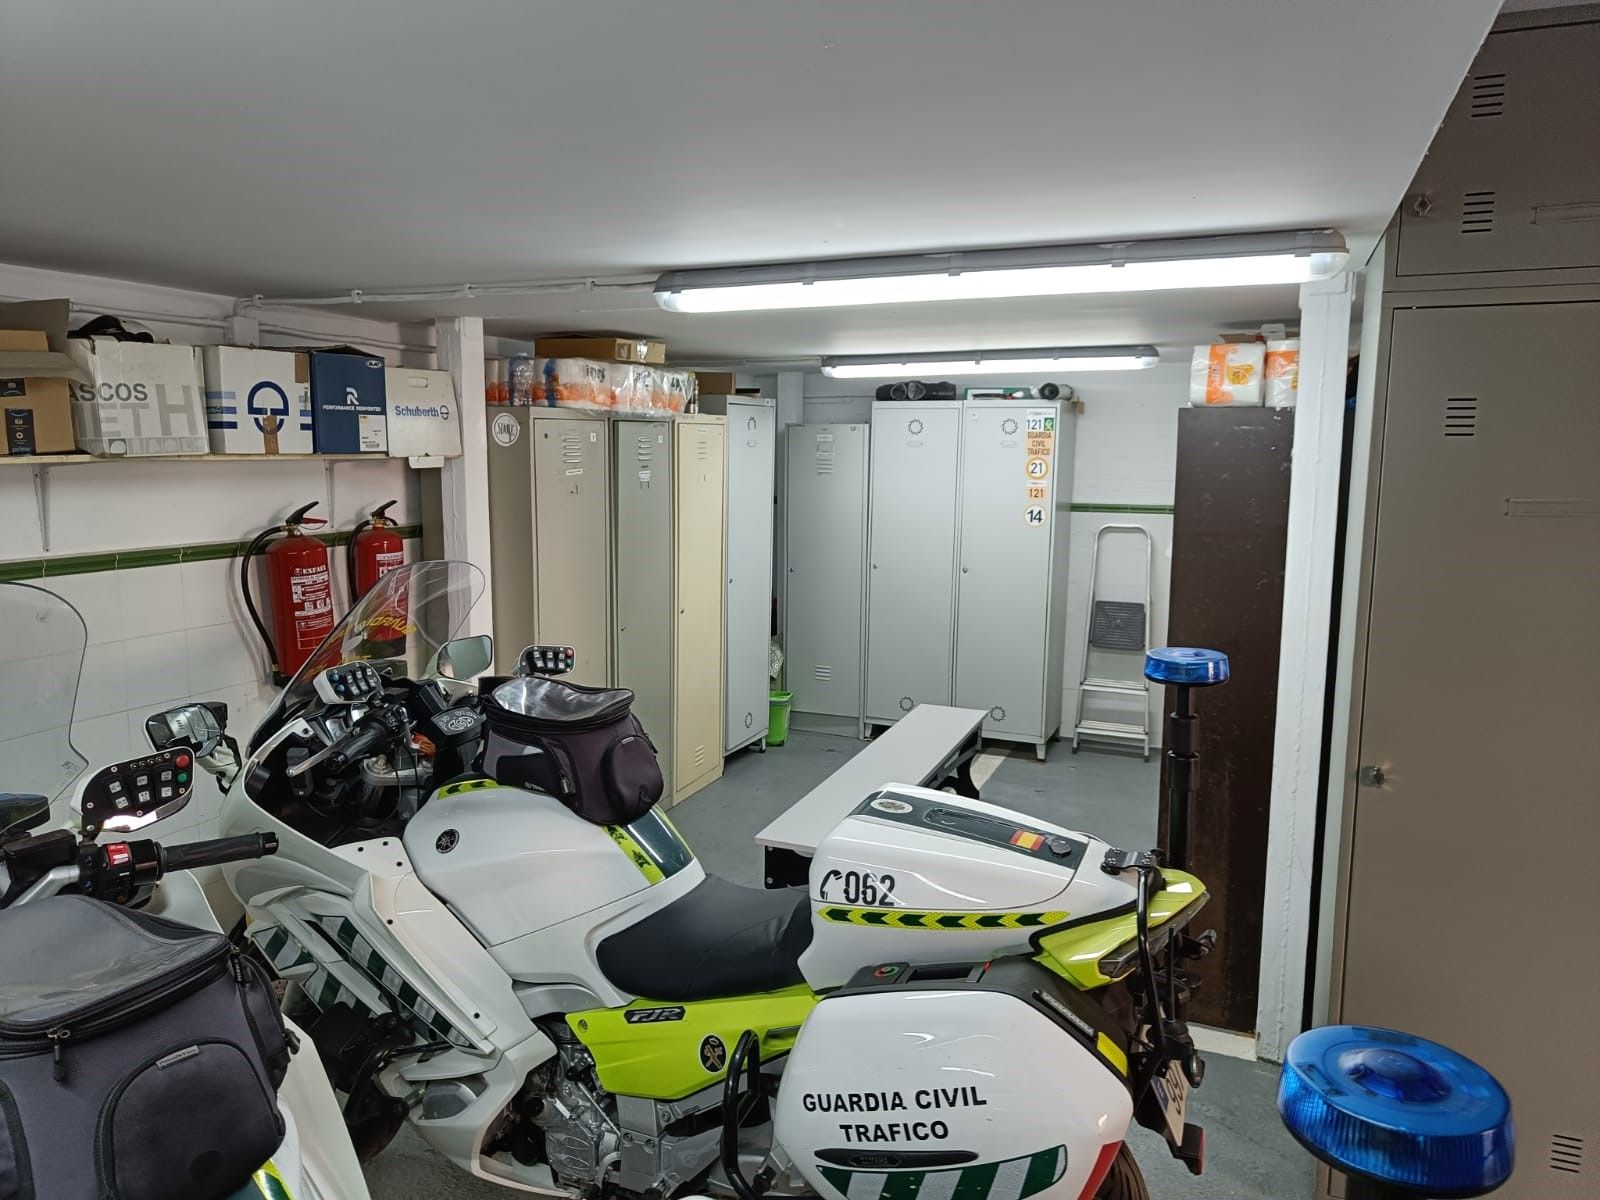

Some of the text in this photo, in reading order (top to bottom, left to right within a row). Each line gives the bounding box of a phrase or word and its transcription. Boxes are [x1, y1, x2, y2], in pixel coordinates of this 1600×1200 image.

[394, 404, 440, 417] Schuberth
[1026, 418, 1042, 430] 121
[1027, 431, 1051, 439] GUARDIA
[1031, 440, 1046, 448] CIVIL
[1027, 448, 1051, 456] TRAFICO
[1030, 462, 1043, 474] 21
[1028, 488, 1044, 498] 121
[1027, 509, 1043, 523] 14
[843, 870, 896, 907] 062
[630, 1008, 681, 1022] FJR
[802, 1086, 987, 1113] GUARDIA CIVIL
[839, 1120, 949, 1143] TRAFICO
